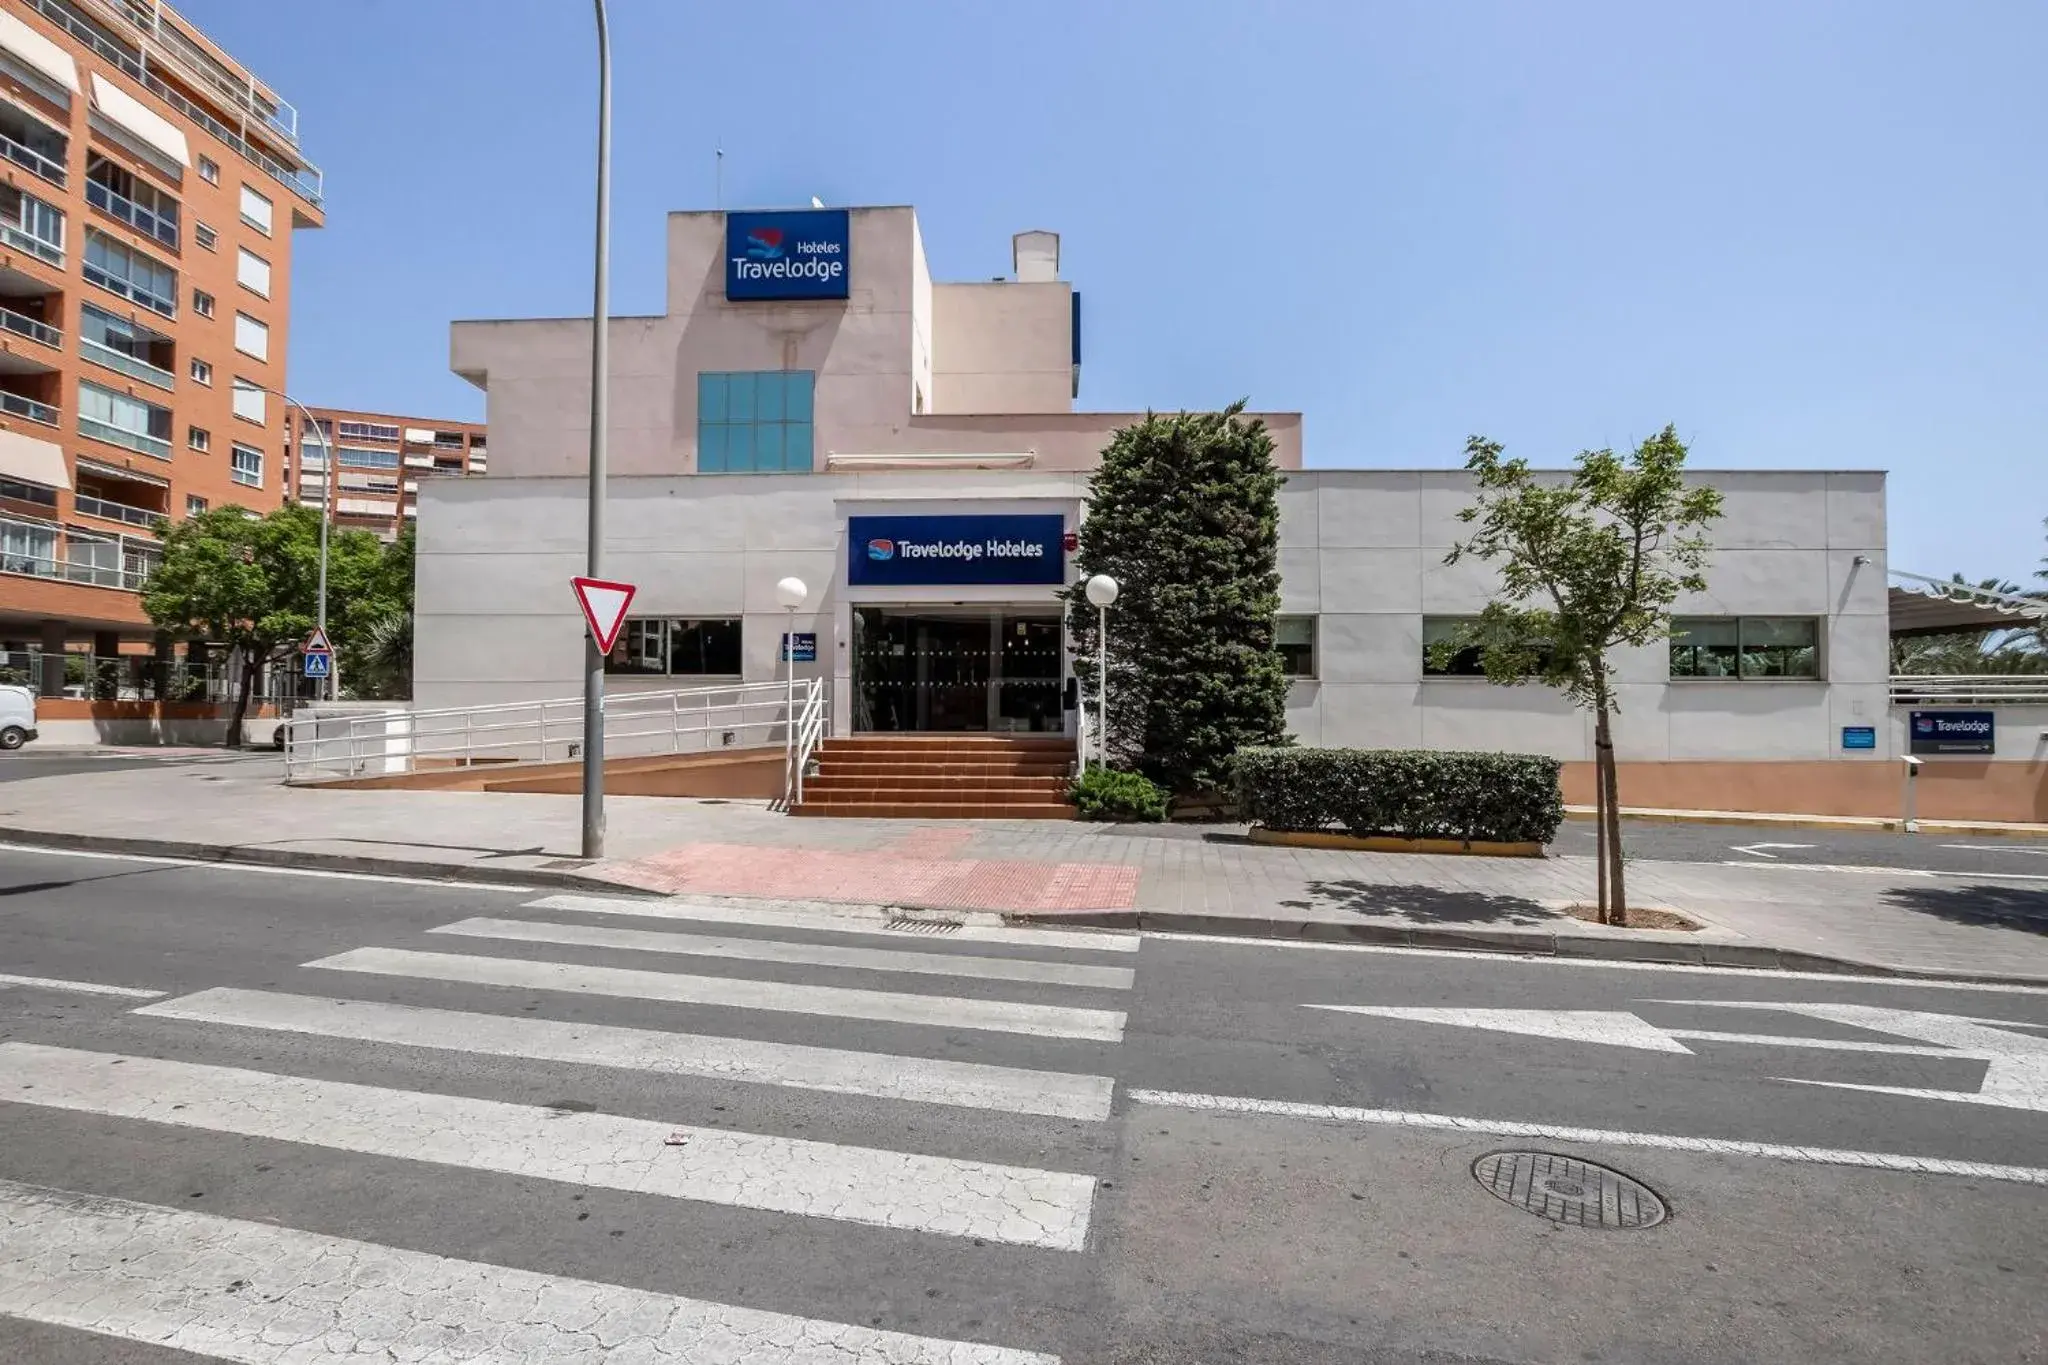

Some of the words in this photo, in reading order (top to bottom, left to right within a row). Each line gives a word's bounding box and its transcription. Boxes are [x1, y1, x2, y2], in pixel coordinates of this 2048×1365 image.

[797, 241, 840, 254] Hoteles
[732, 257, 842, 281] Travelodge
[898, 541, 982, 560] Travelodge
[986, 540, 1043, 557] Hoteles
[784, 643, 814, 651] Trvelodge
[1936, 720, 1990, 733] Travelodge
